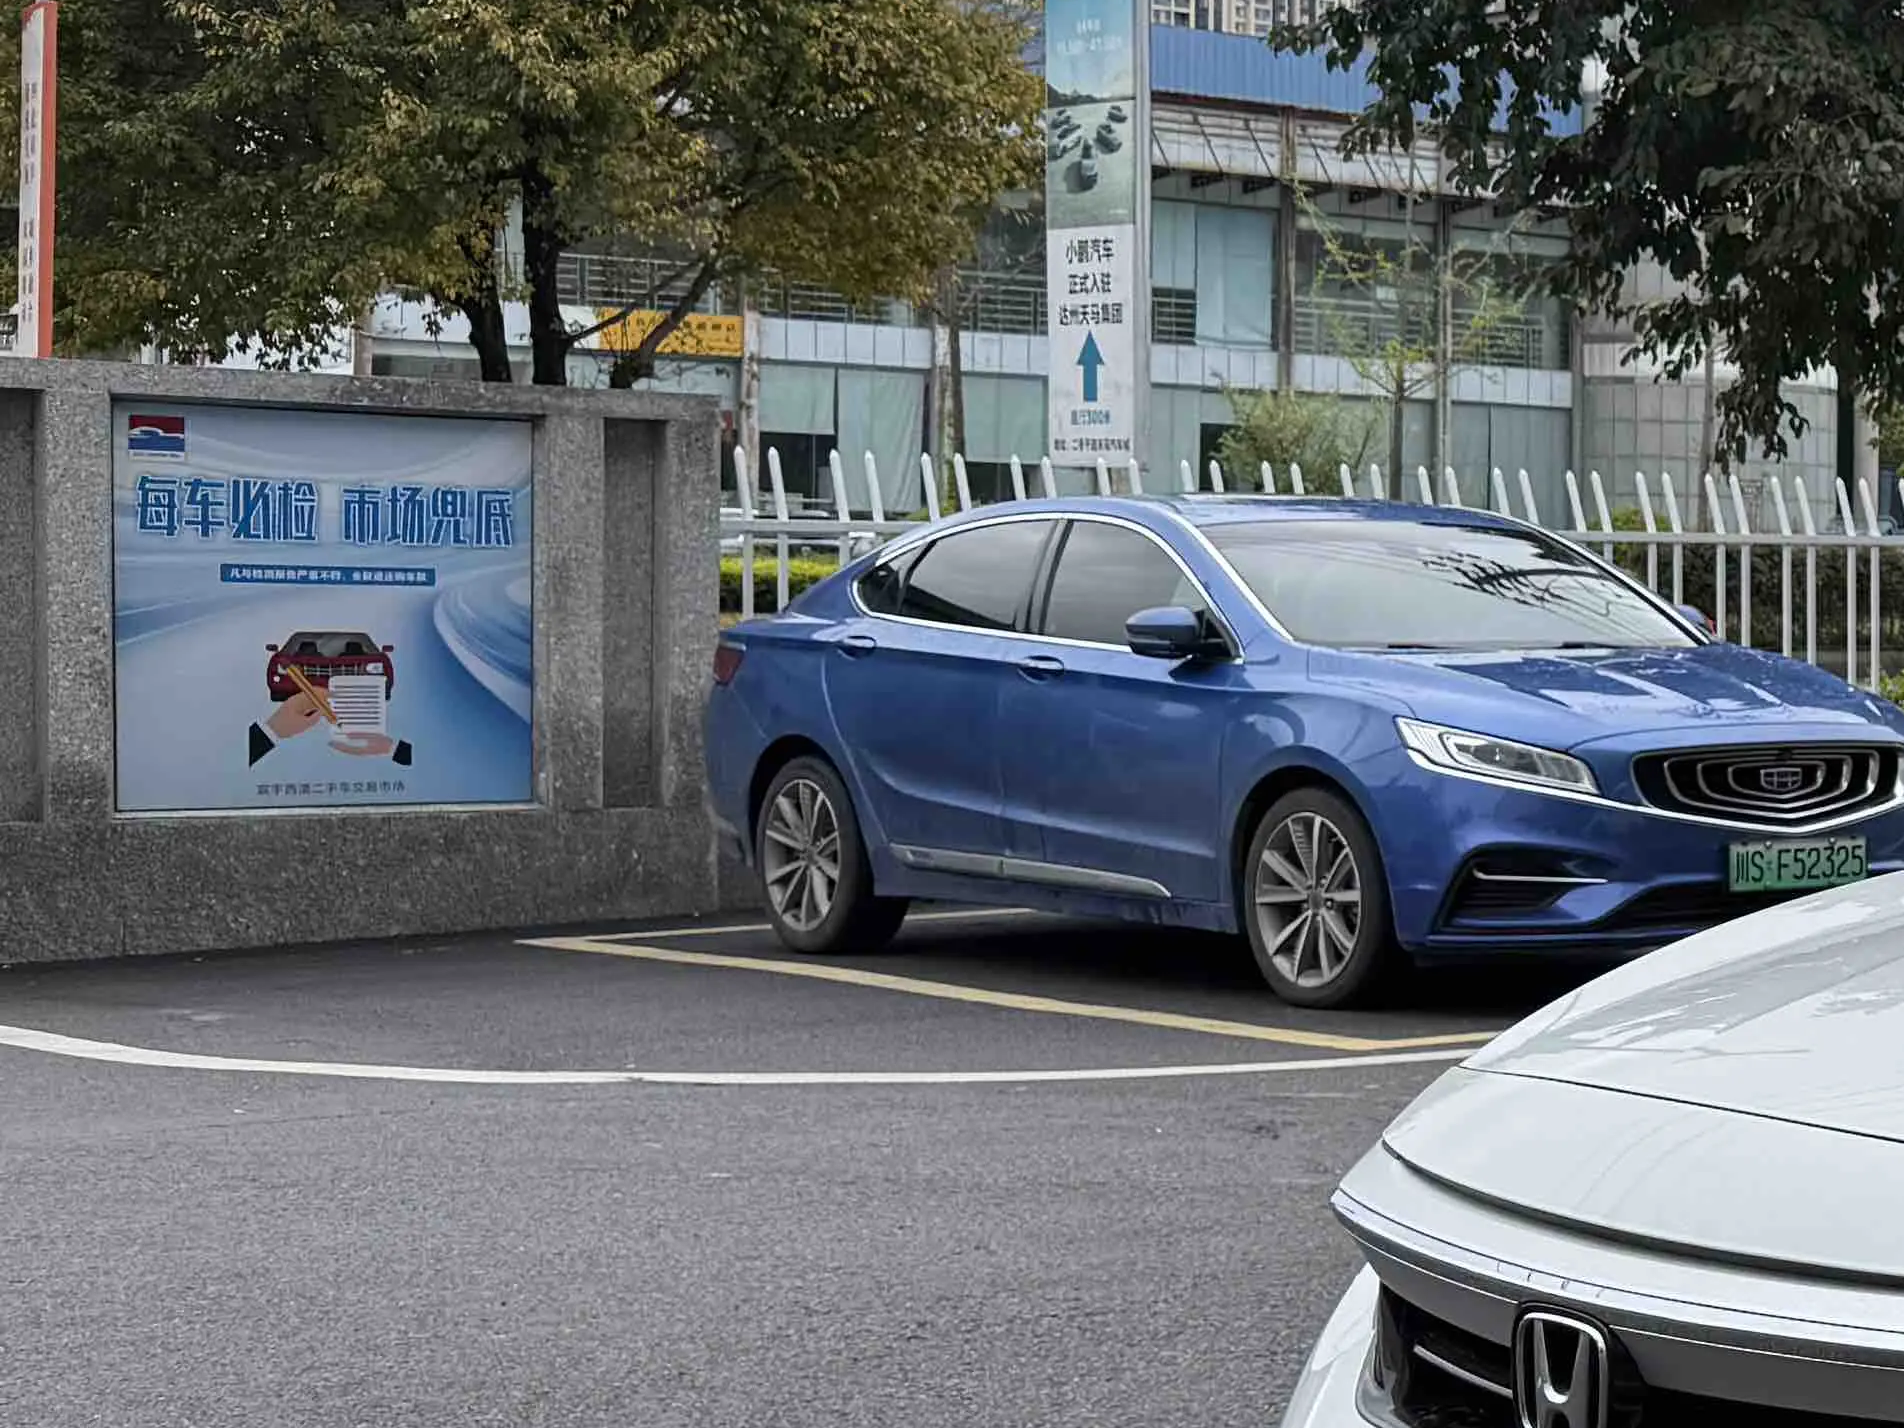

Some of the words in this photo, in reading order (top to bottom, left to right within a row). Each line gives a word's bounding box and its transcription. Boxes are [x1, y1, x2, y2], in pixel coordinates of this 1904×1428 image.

[1065, 239, 1114, 264] 小鹏汽车
[1067, 272, 1112, 294] 正式入驻
[136, 474, 319, 543] 每车必检
[341, 484, 514, 548] 市场兜底
